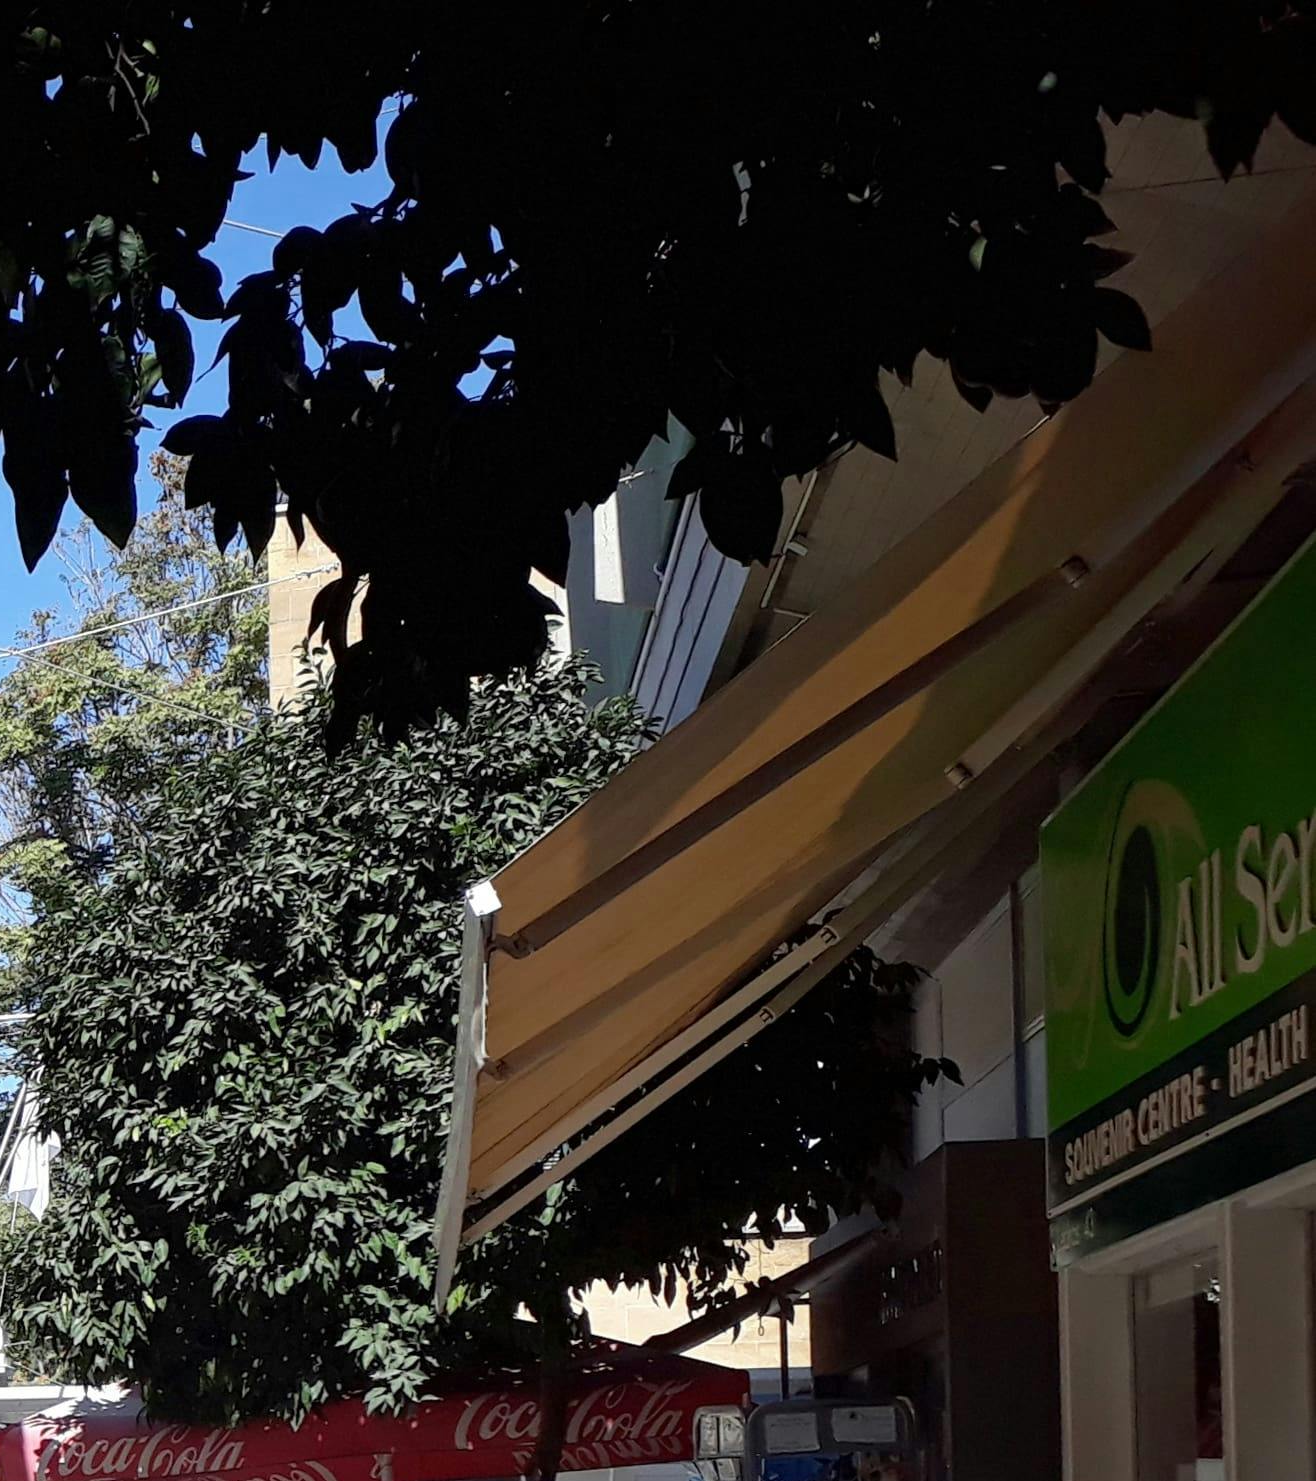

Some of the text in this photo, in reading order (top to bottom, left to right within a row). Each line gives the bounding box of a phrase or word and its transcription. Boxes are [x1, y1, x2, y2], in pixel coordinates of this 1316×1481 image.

[1169, 850, 1226, 1019] All
[1065, 1107, 1136, 1185] SOUVENIR
[1137, 1065, 1206, 1145] CENTRE
[1228, 1004, 1308, 1099] HEALTH
